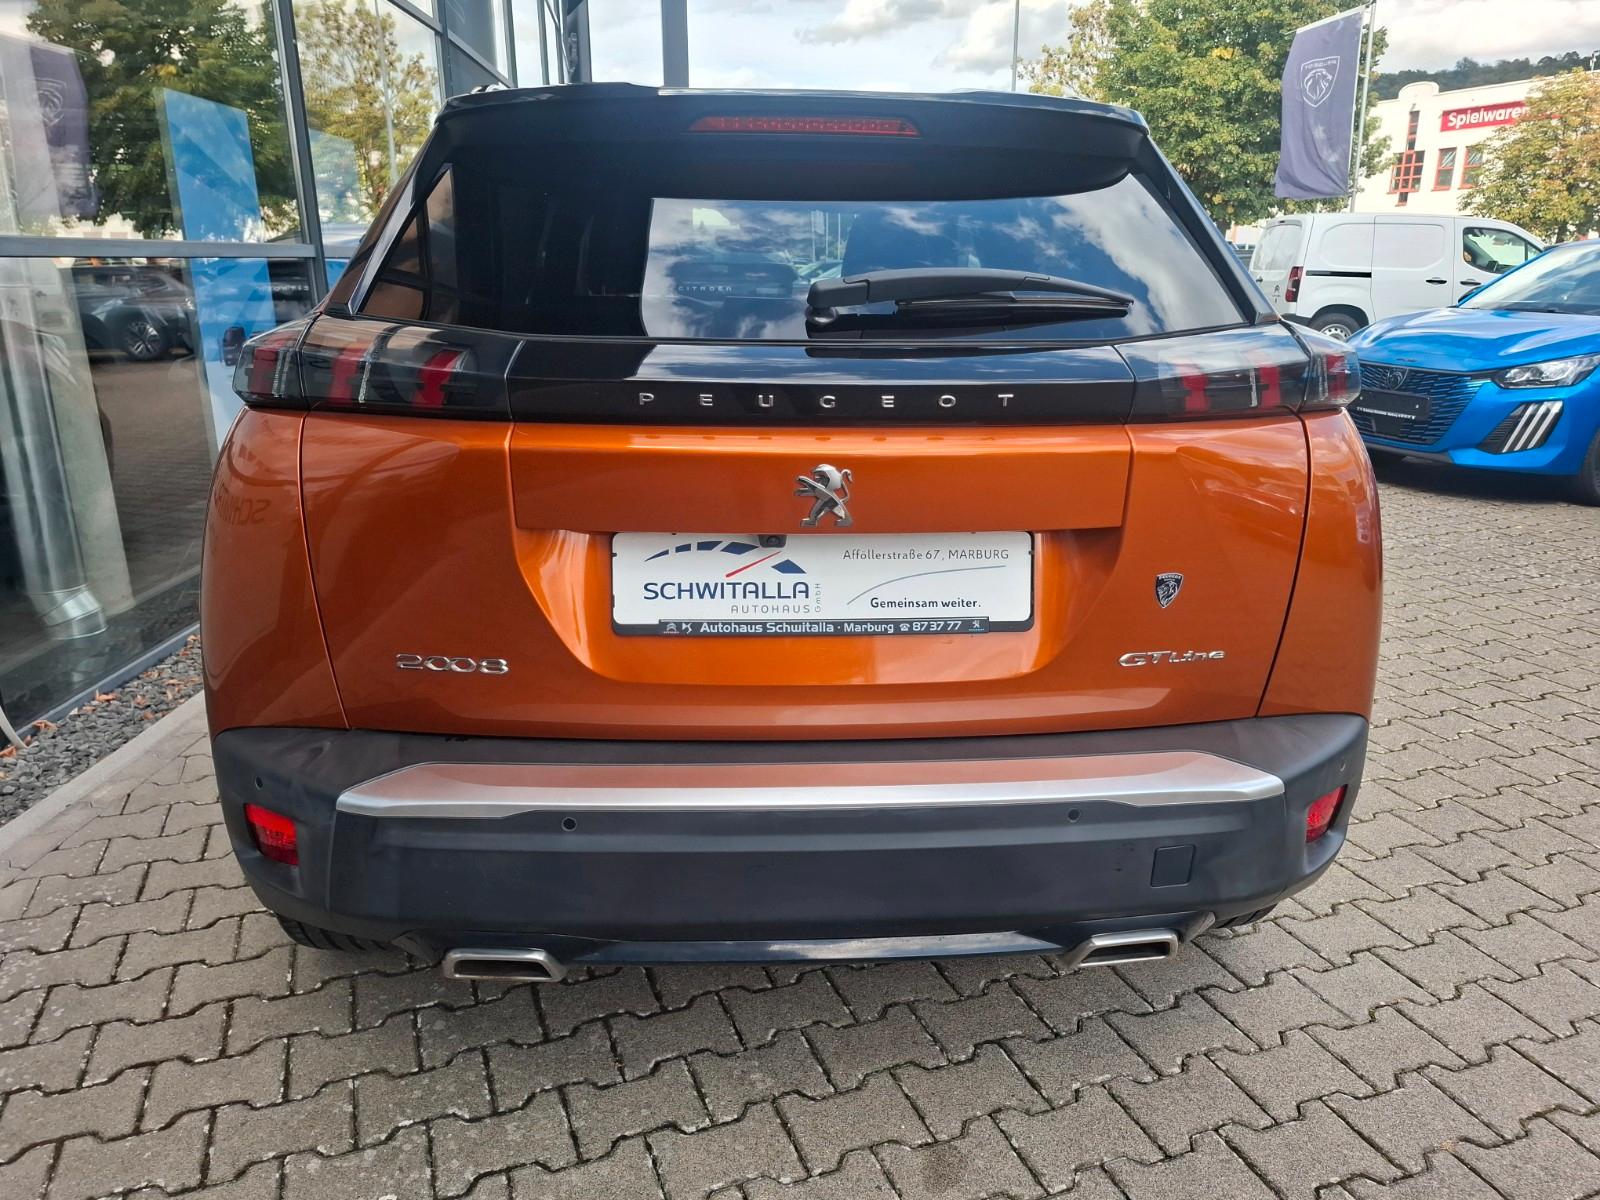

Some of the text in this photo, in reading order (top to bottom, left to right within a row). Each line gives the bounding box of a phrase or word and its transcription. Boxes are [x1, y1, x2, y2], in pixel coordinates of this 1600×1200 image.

[638, 393, 1014, 408] PEUGEOT
[843, 548, 922, 560] Afföllerstraße
[948, 549, 1009, 560] MARBURG
[643, 581, 809, 600] SCHWITALLA
[870, 596, 981, 608] Gemeinsam weiter.
[731, 604, 810, 614] AUTOHAUS
[700, 622, 763, 633] Autohaus
[766, 622, 834, 633] Schwitalla
[843, 622, 894, 634] Marburg
[396, 653, 509, 674] 2008
